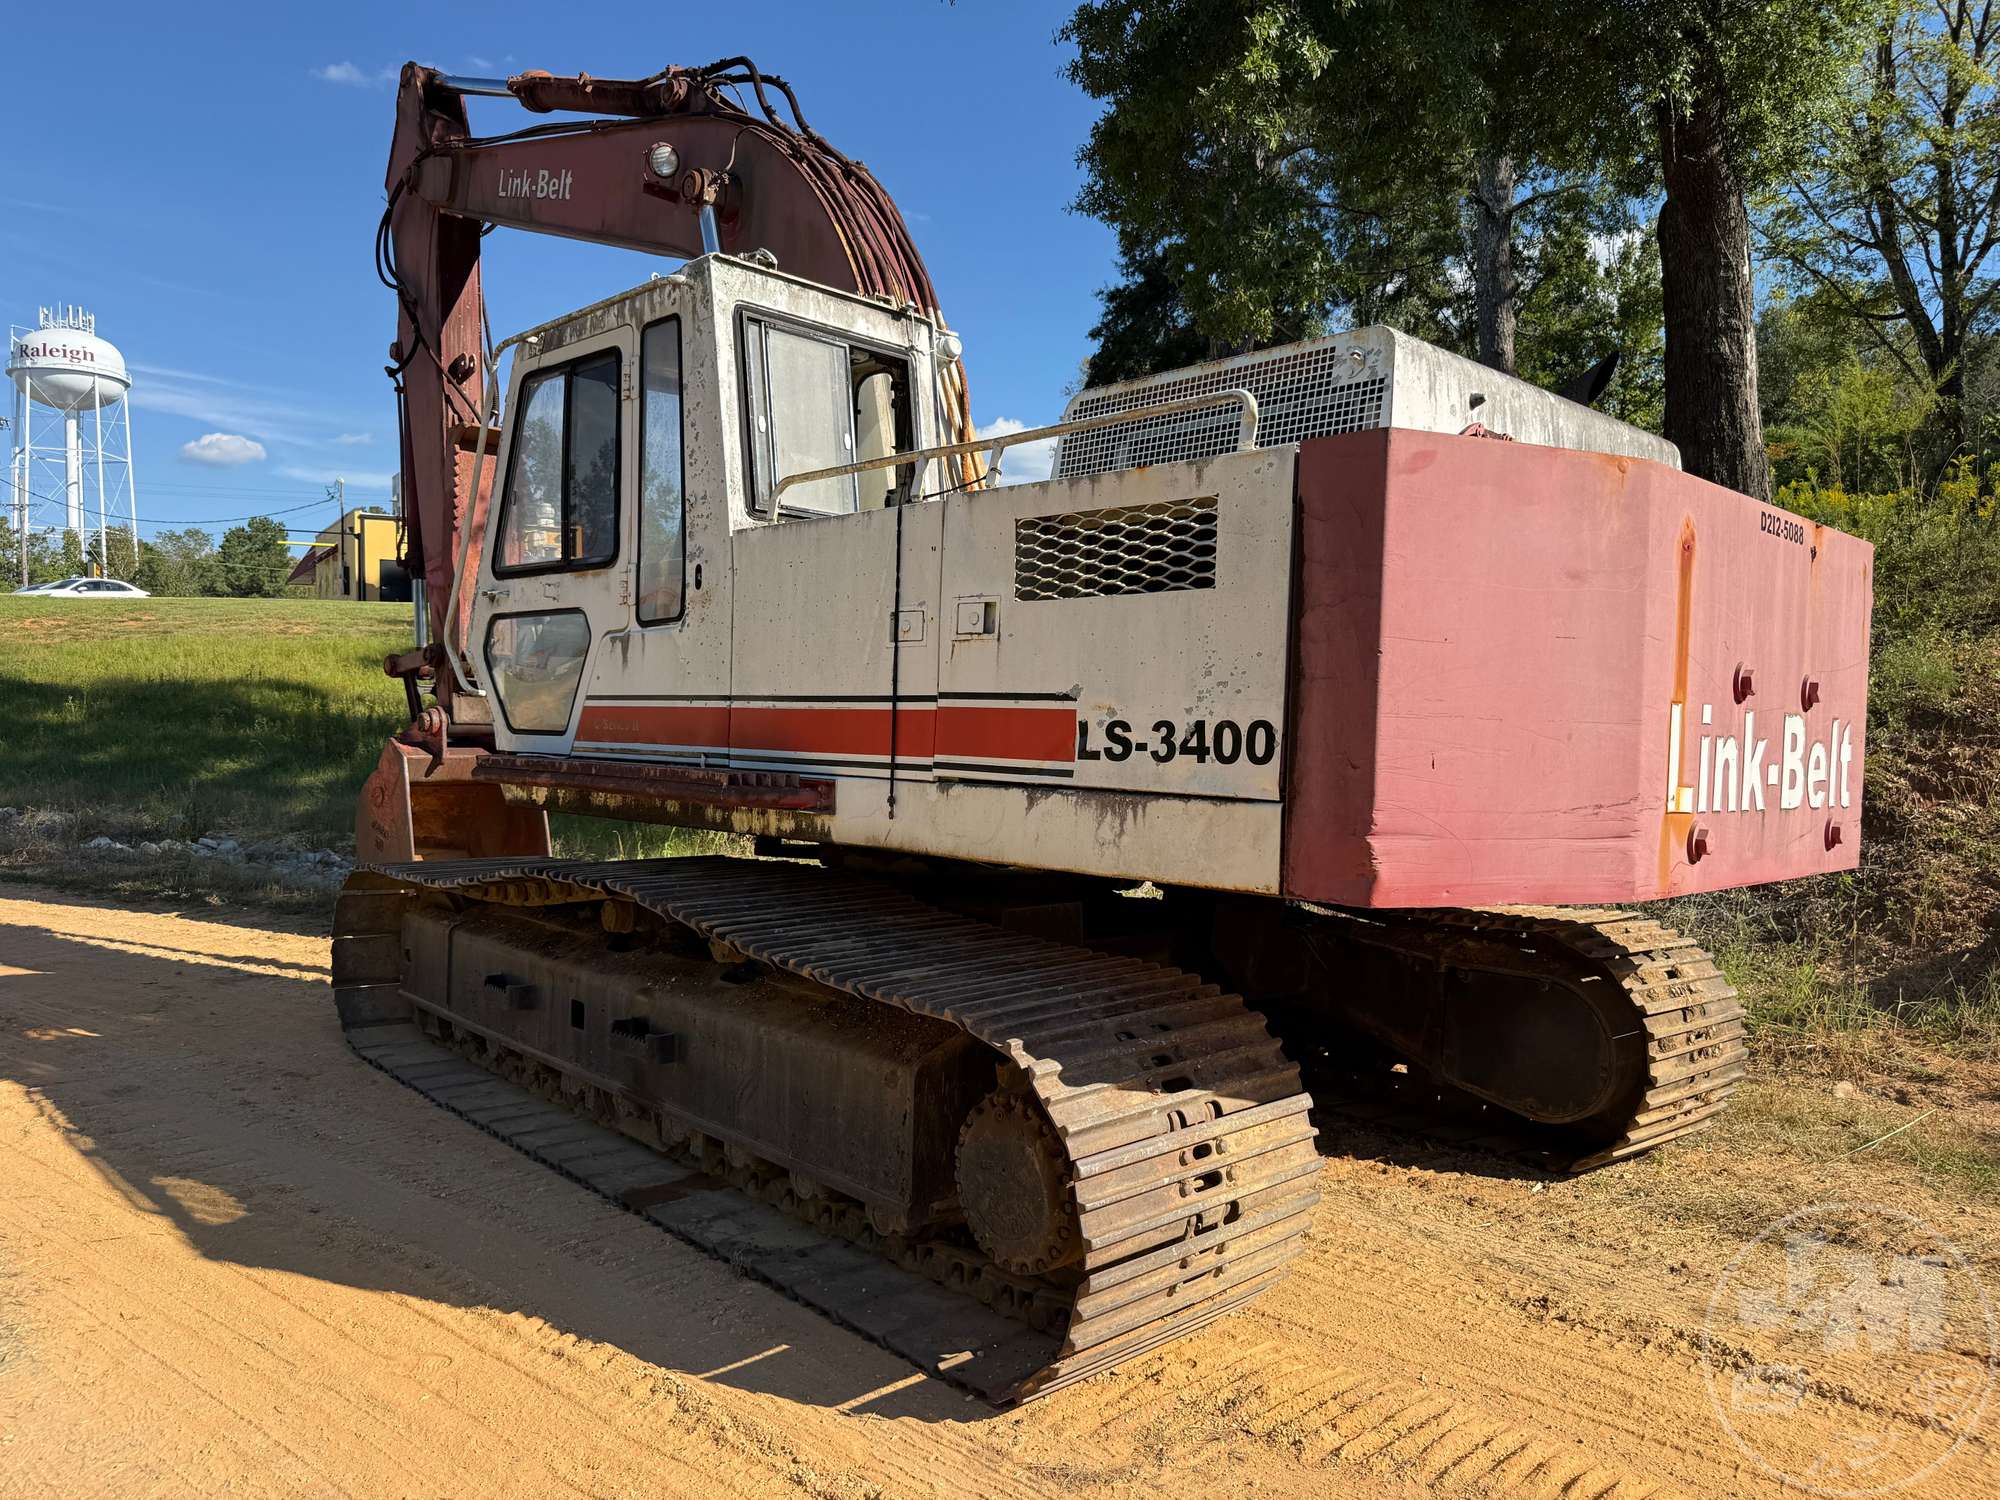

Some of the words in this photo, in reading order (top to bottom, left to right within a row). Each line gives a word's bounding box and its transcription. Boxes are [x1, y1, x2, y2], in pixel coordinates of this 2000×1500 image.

[498, 168, 573, 200] Link-Belt
[20, 343, 95, 363] Raleigh
[1760, 511, 1804, 545] D212-5088
[1077, 719, 1277, 766] LS-3400
[1666, 703, 1852, 813] Link-Belt
